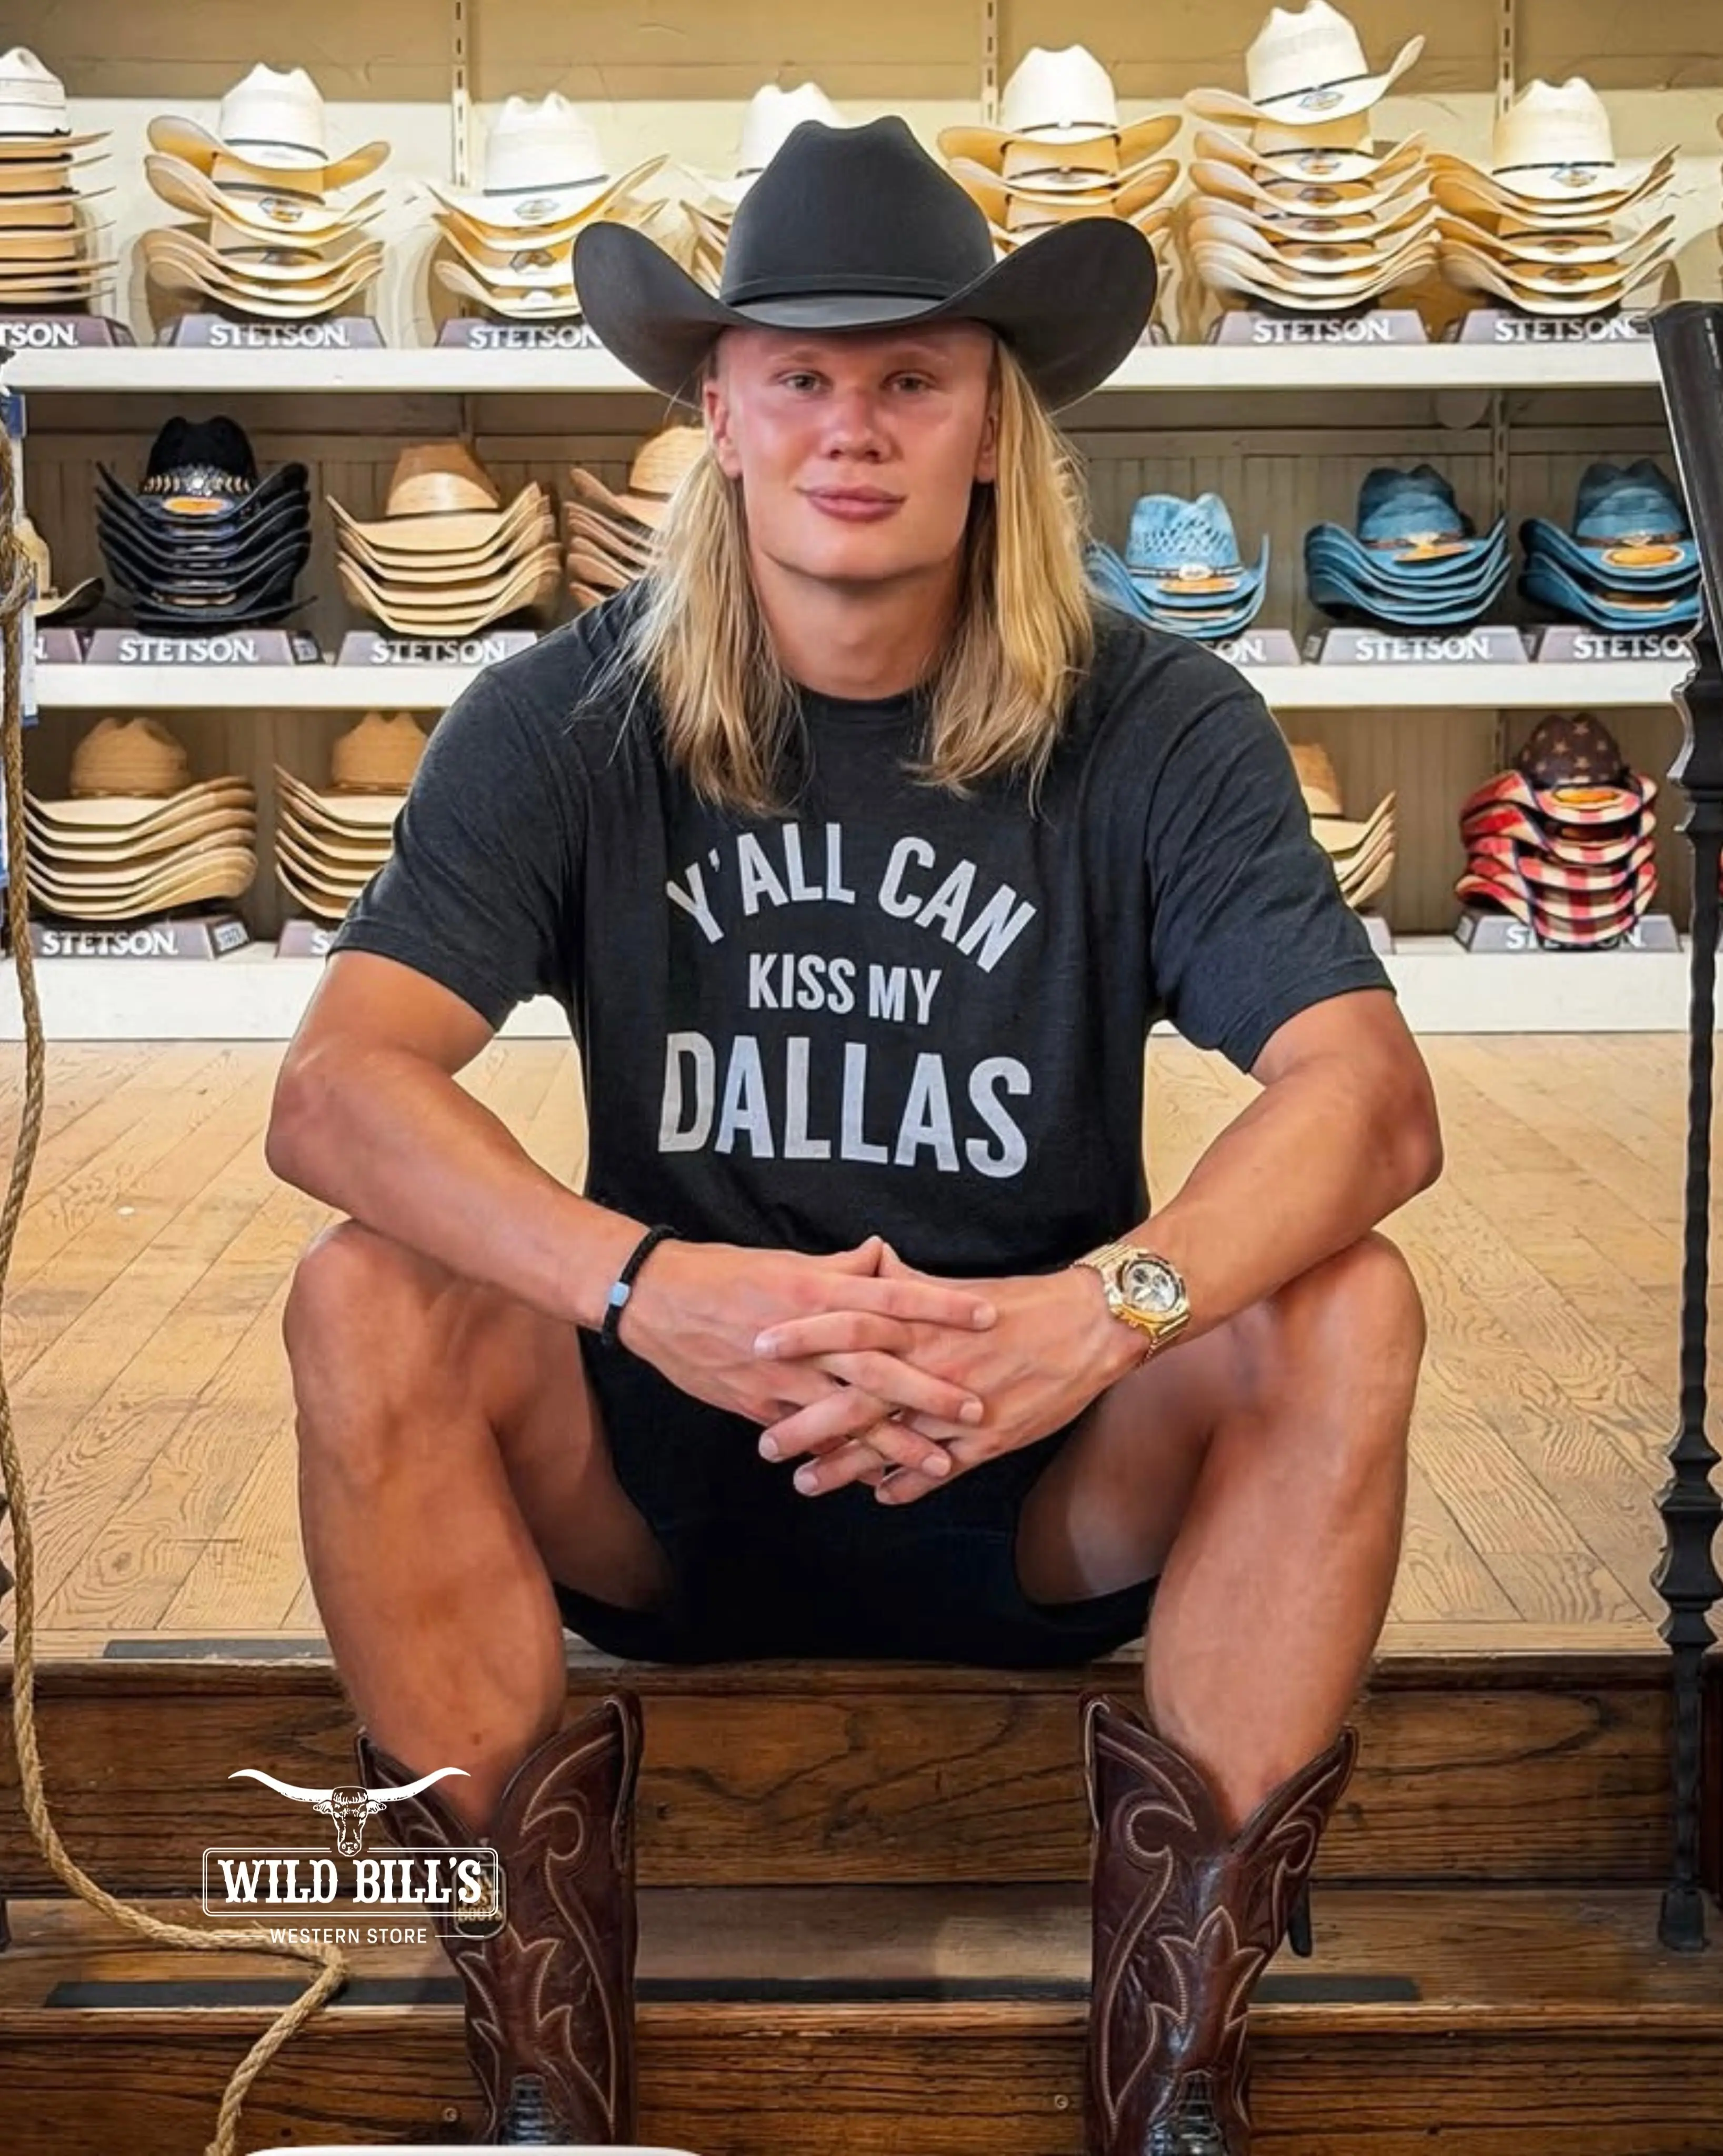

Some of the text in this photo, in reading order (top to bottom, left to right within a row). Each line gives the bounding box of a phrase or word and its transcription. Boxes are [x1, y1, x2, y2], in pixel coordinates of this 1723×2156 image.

[209, 324, 349, 347] STETSON
[1252, 318, 1396, 343] STETSON
[1494, 317, 1637, 341] STETSON
[118, 637, 258, 662] STETSON
[370, 638, 505, 664] STETSON
[1356, 636, 1493, 661] STETSON
[1572, 634, 1691, 658] STETSO
[666, 823, 1037, 973] Y'ALL CAN
[42, 930, 179, 956] STETSON
[748, 954, 942, 1025] KISS MY
[658, 1031, 1031, 1179] DALLAS
